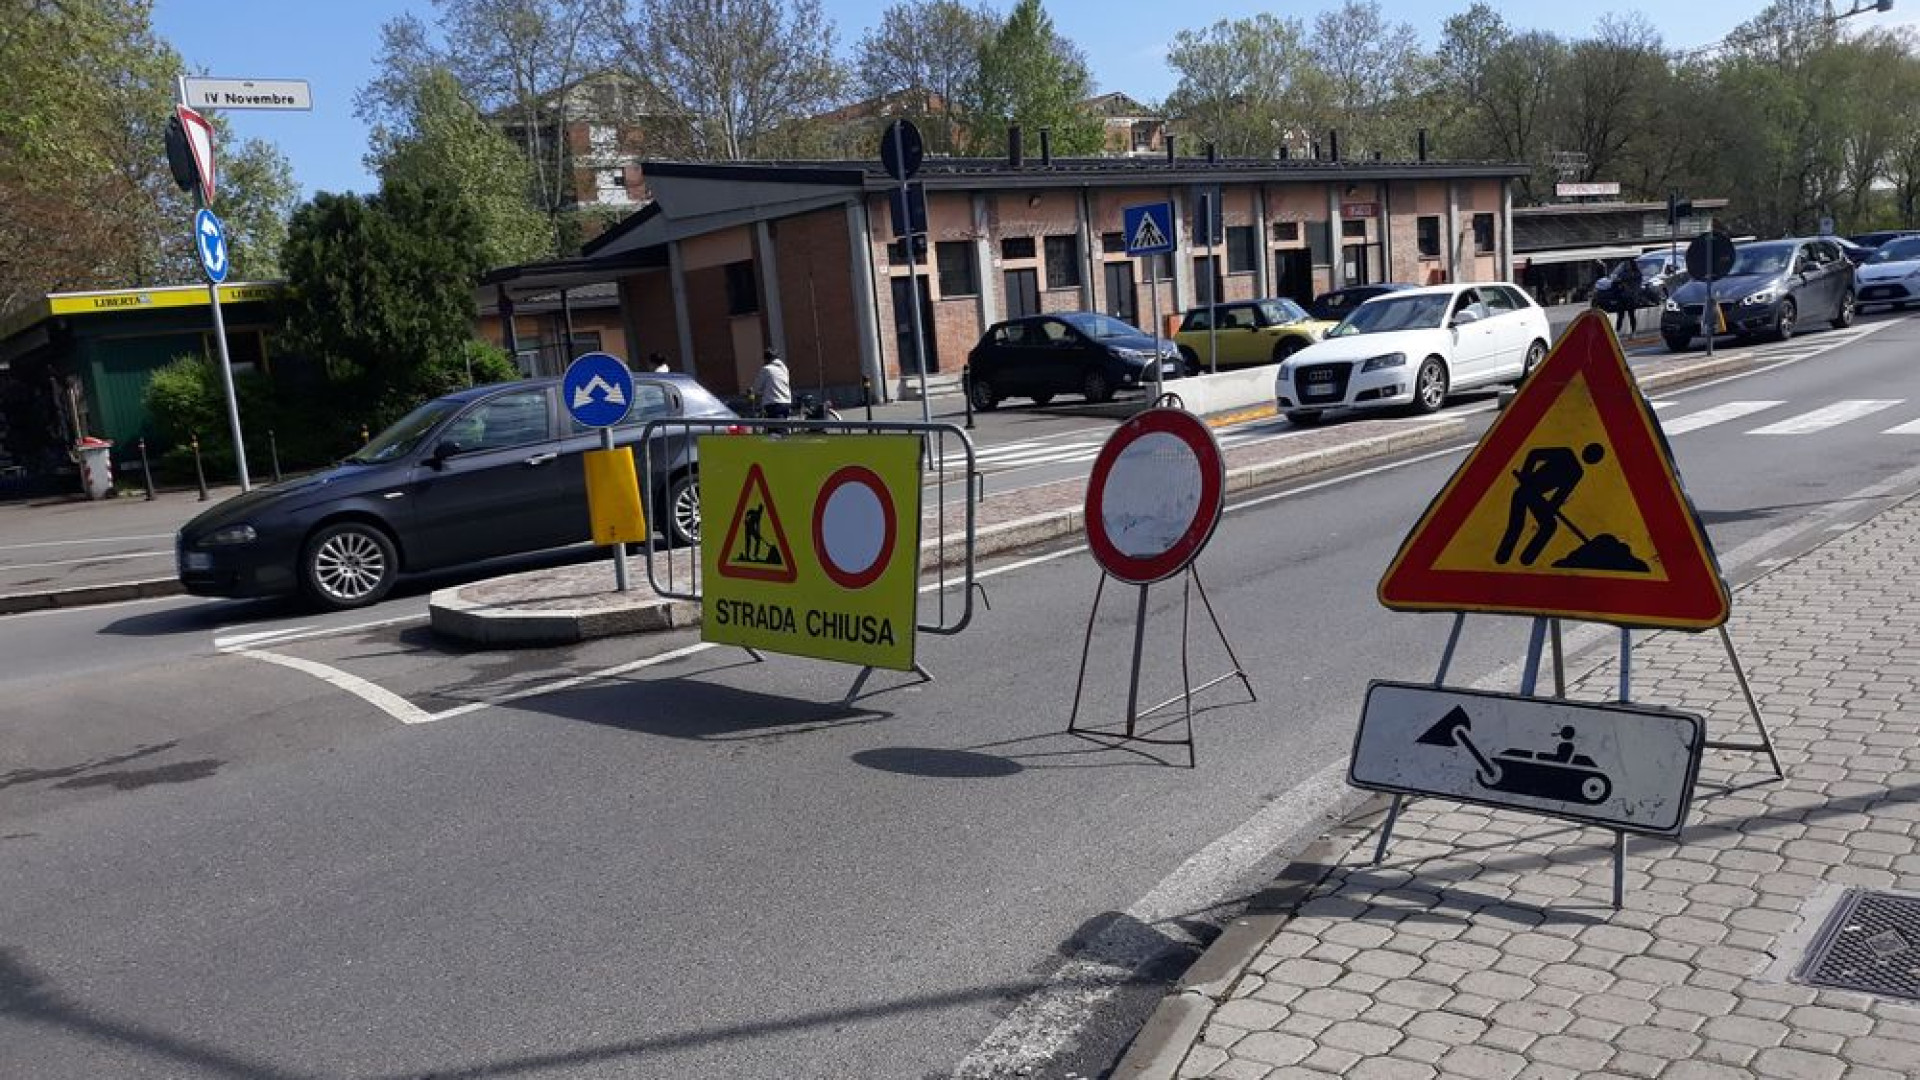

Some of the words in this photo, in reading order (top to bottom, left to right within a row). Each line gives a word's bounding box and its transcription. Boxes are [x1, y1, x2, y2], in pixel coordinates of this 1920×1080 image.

[204, 92, 218, 104] IV
[225, 93, 295, 104] Novembre
[716, 599, 796, 633] STRADA
[806, 610, 894, 646] CHIUSA
